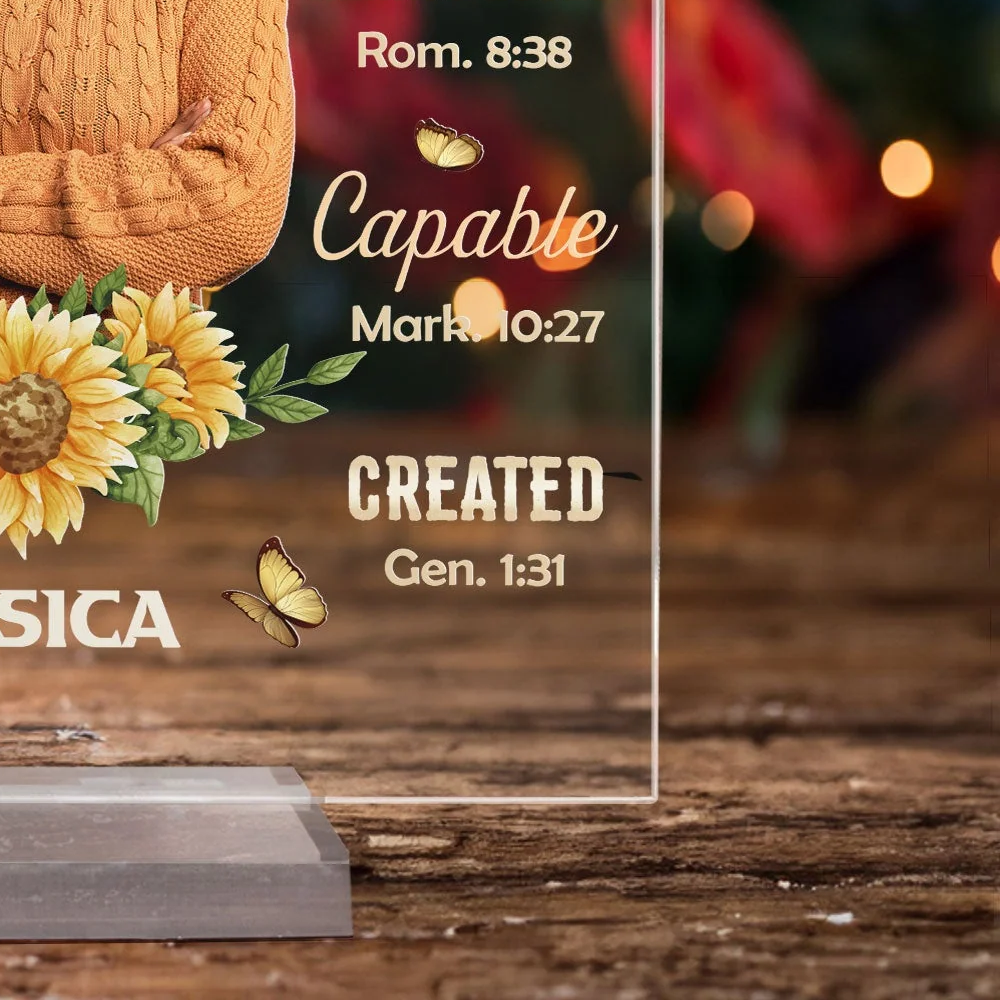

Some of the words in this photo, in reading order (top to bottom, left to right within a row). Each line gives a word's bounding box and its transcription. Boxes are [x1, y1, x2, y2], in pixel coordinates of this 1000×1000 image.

[357, 30, 473, 70] Rom.
[486, 33, 573, 70] 8:38
[312, 170, 618, 293] Capable
[352, 304, 485, 344] Mark.
[497, 308, 605, 344] 10:27
[347, 454, 605, 522] CREATED
[384, 549, 486, 587] Gen.
[499, 552, 566, 587] 1:31
